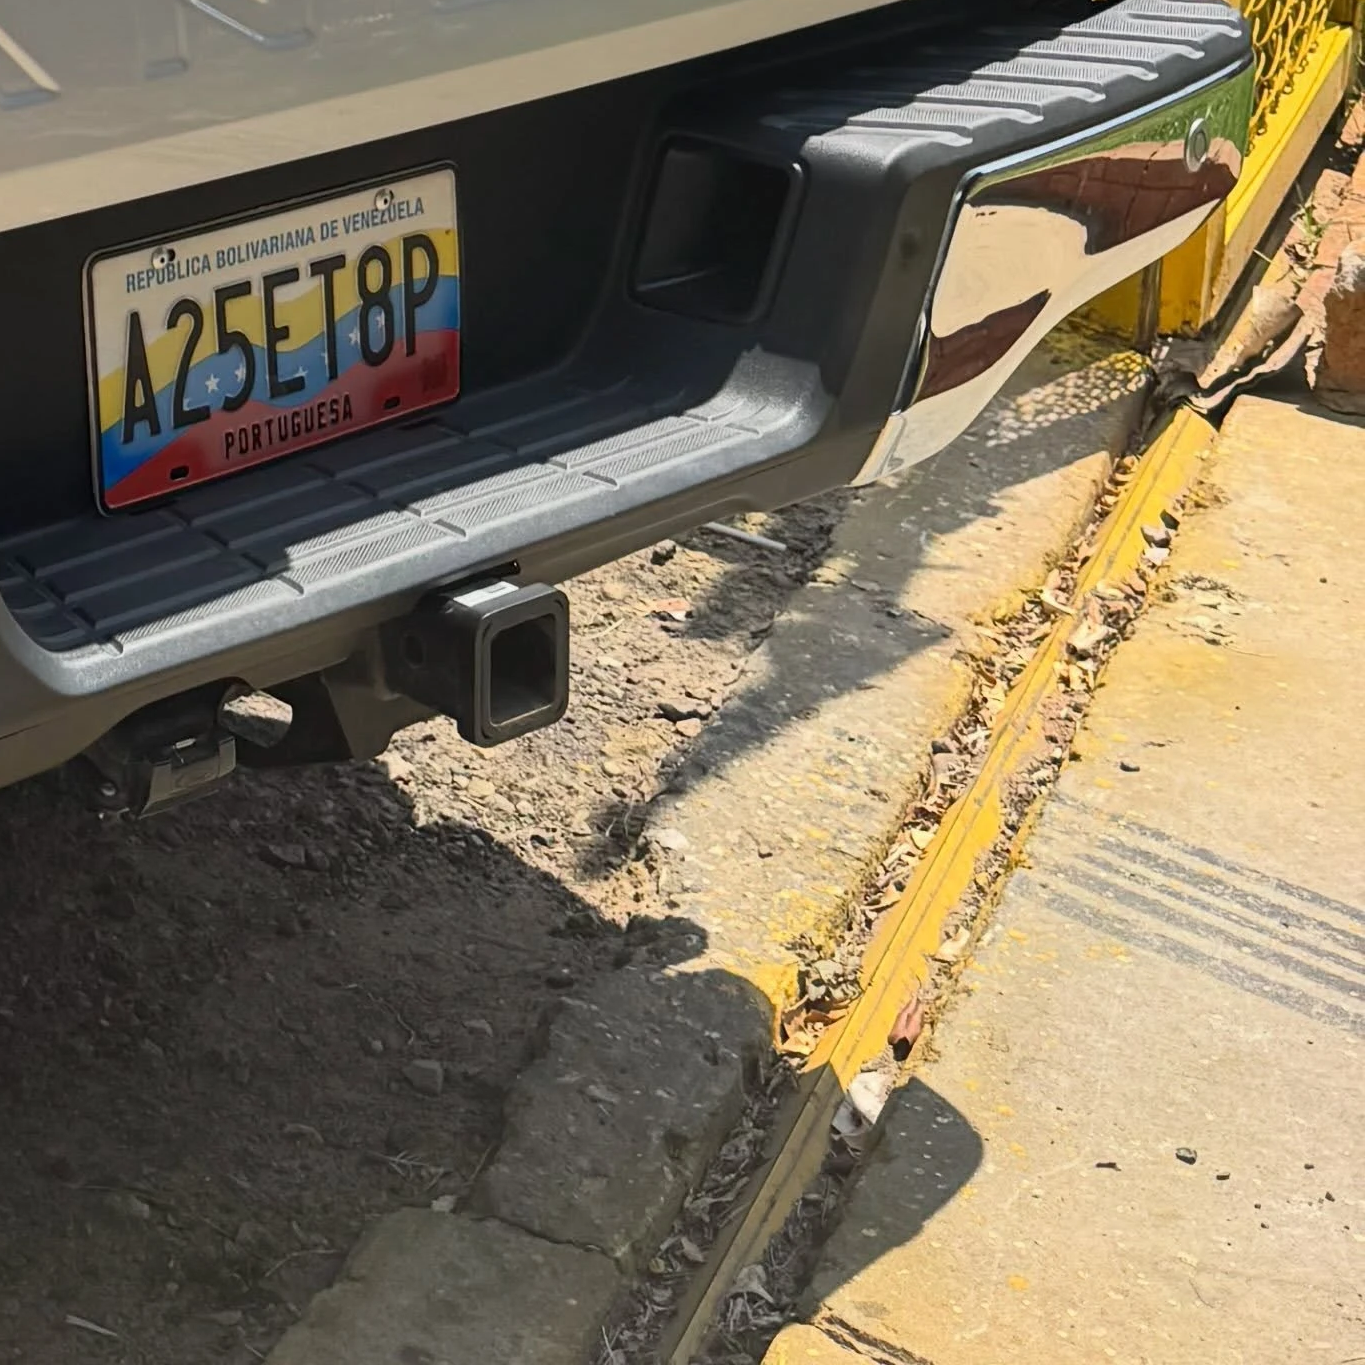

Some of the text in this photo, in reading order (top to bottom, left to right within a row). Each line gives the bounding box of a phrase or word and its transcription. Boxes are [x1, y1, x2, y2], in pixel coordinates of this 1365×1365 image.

[216, 225, 316, 270] BOLIVARIANA
[320, 219, 339, 242] DE
[121, 233, 440, 445] A25ET8P
[224, 393, 354, 460] PORTUGUESA
